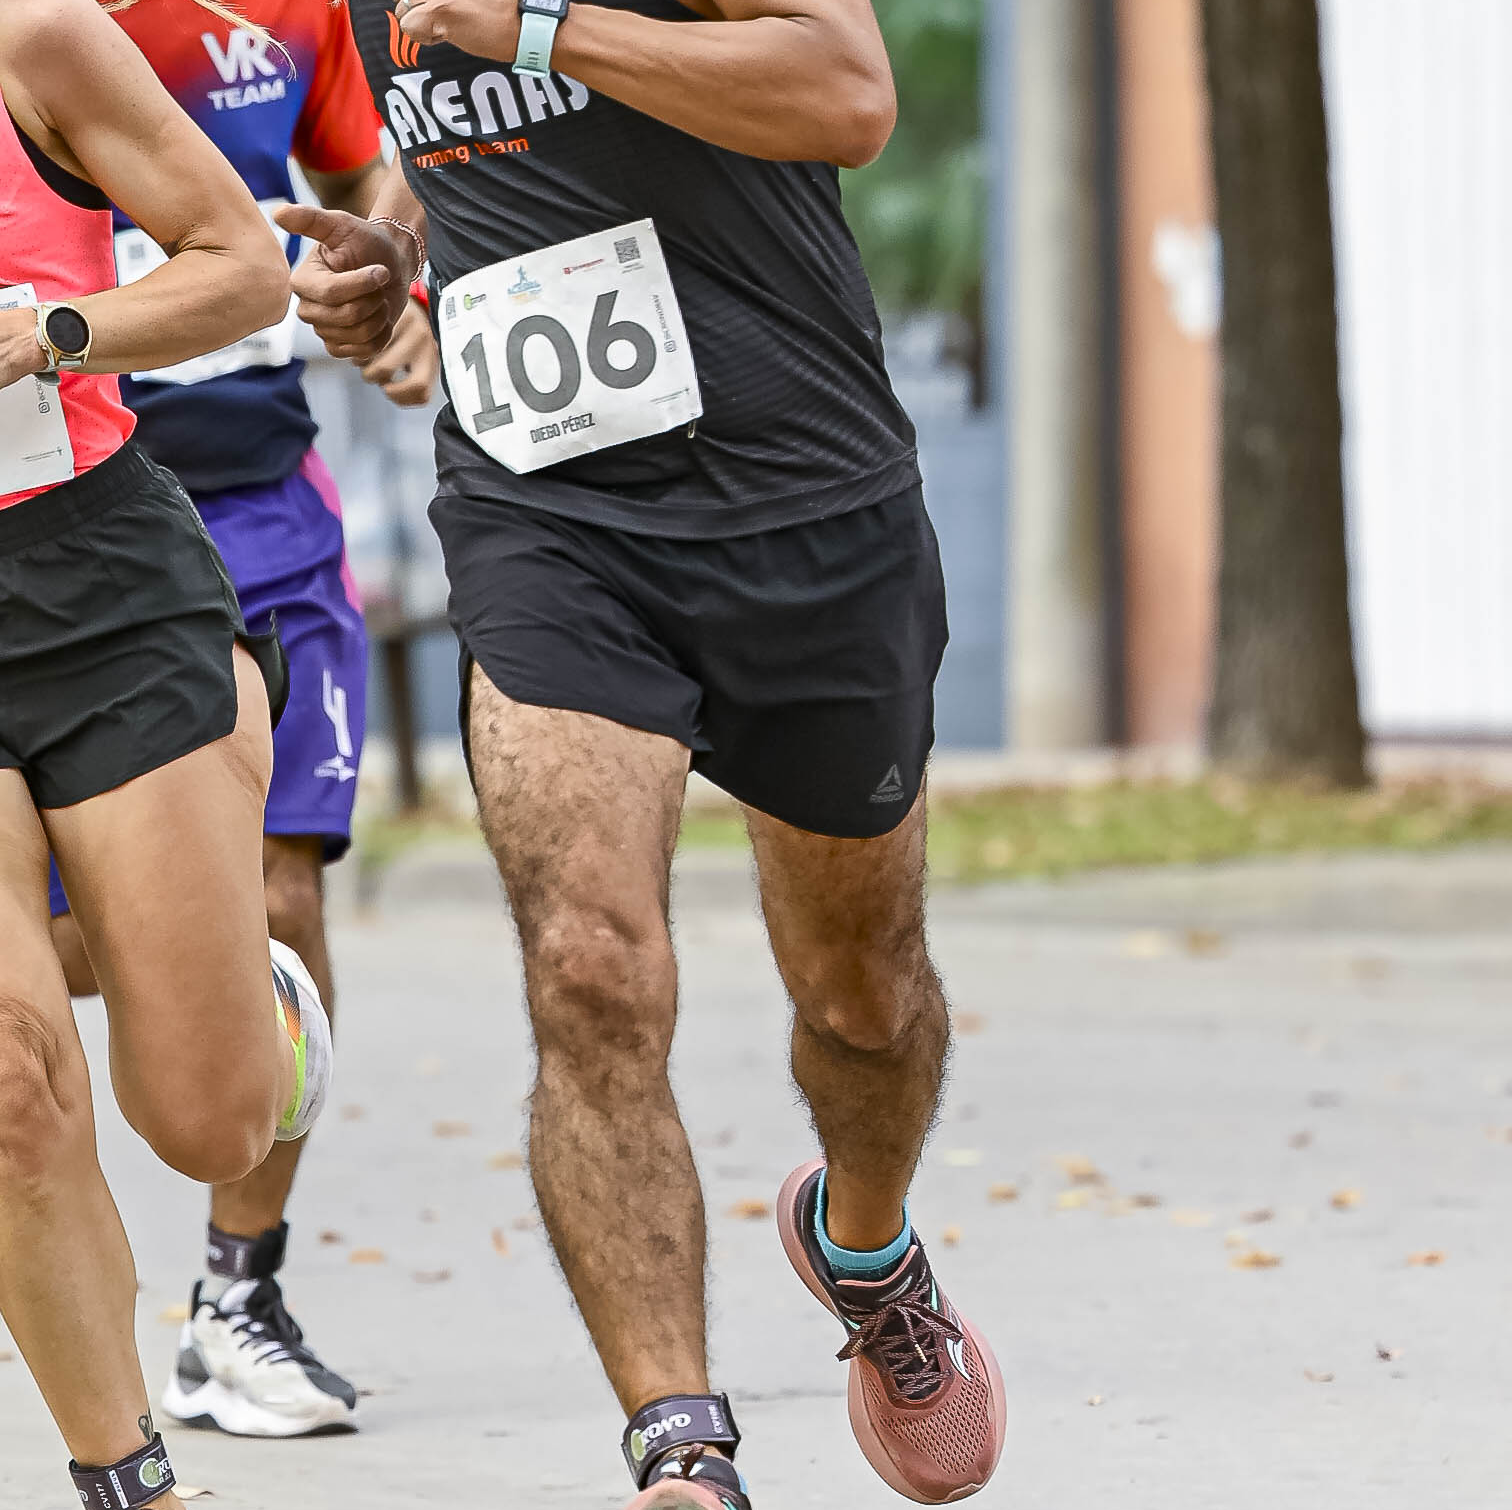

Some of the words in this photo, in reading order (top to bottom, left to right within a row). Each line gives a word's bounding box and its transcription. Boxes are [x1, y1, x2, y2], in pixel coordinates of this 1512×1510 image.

[201, 27, 277, 83] VR
[207, 79, 286, 111] TEAM
[474, 138, 529, 155] tam
[461, 290, 657, 435] 106
[530, 423, 561, 443] DIEGO
[561, 413, 596, 435] PÉREZ
